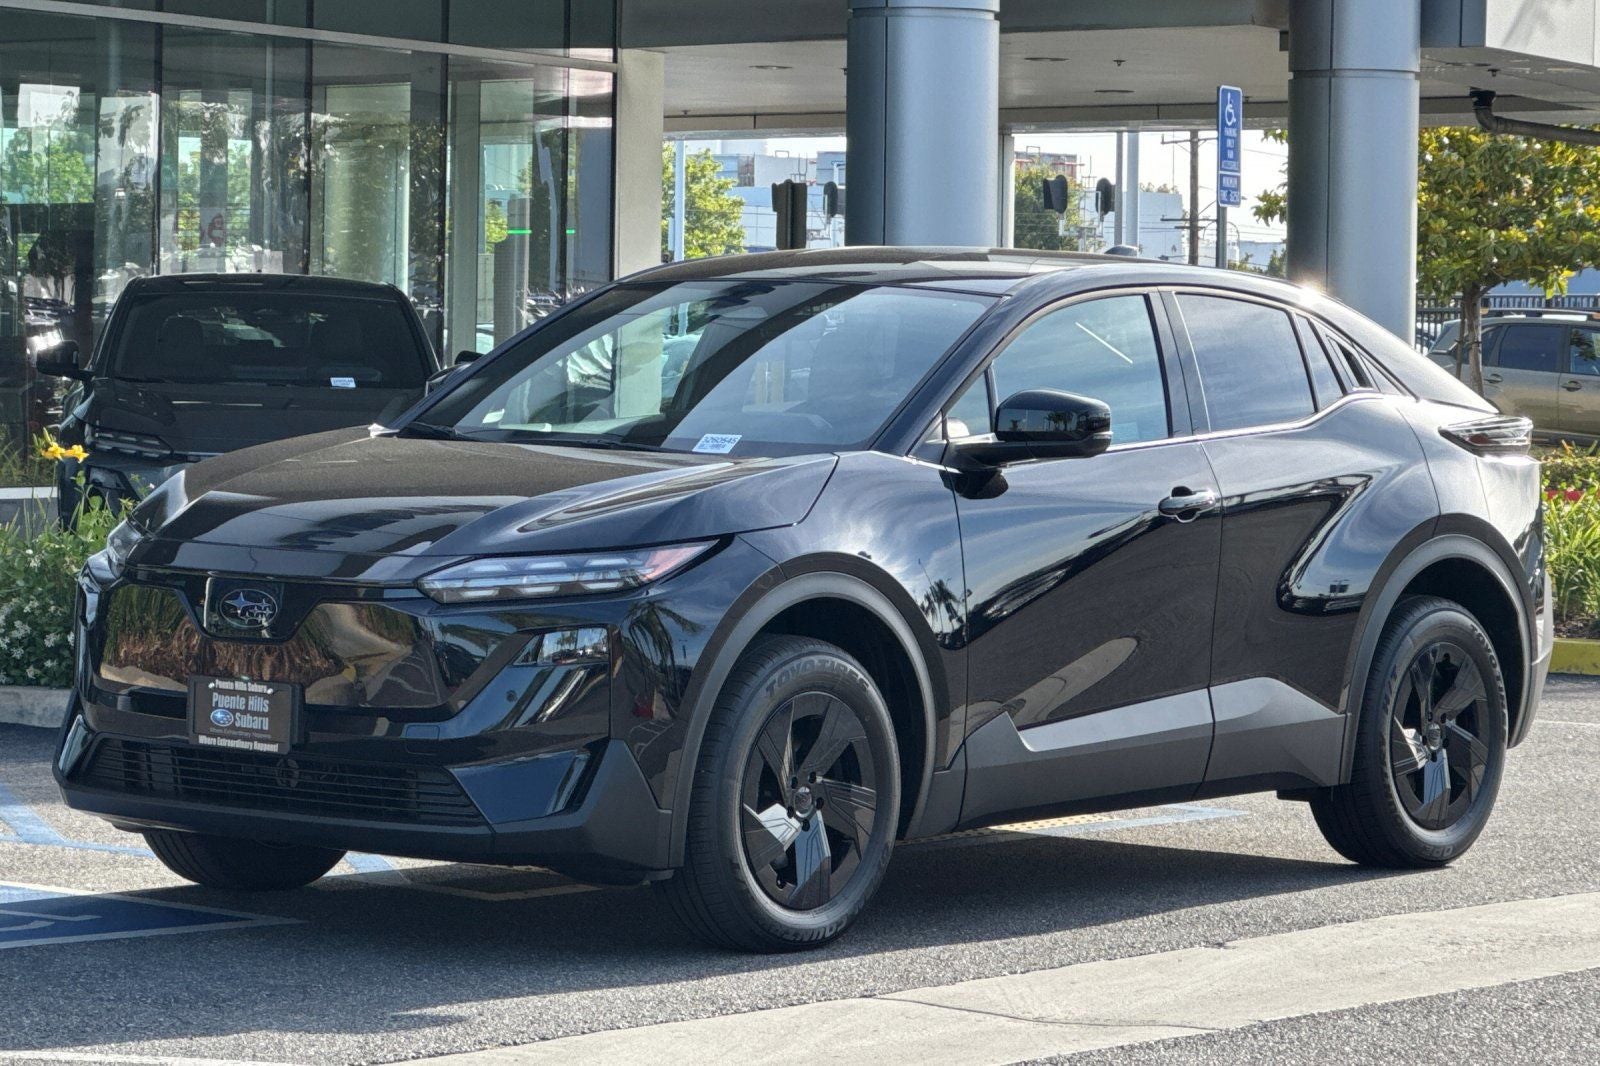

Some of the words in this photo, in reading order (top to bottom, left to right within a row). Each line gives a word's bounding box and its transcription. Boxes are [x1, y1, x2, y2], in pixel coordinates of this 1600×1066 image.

[212, 692, 245, 710] Puente
[248, 695, 269, 712] Hills
[235, 713, 269, 730] Subaru
